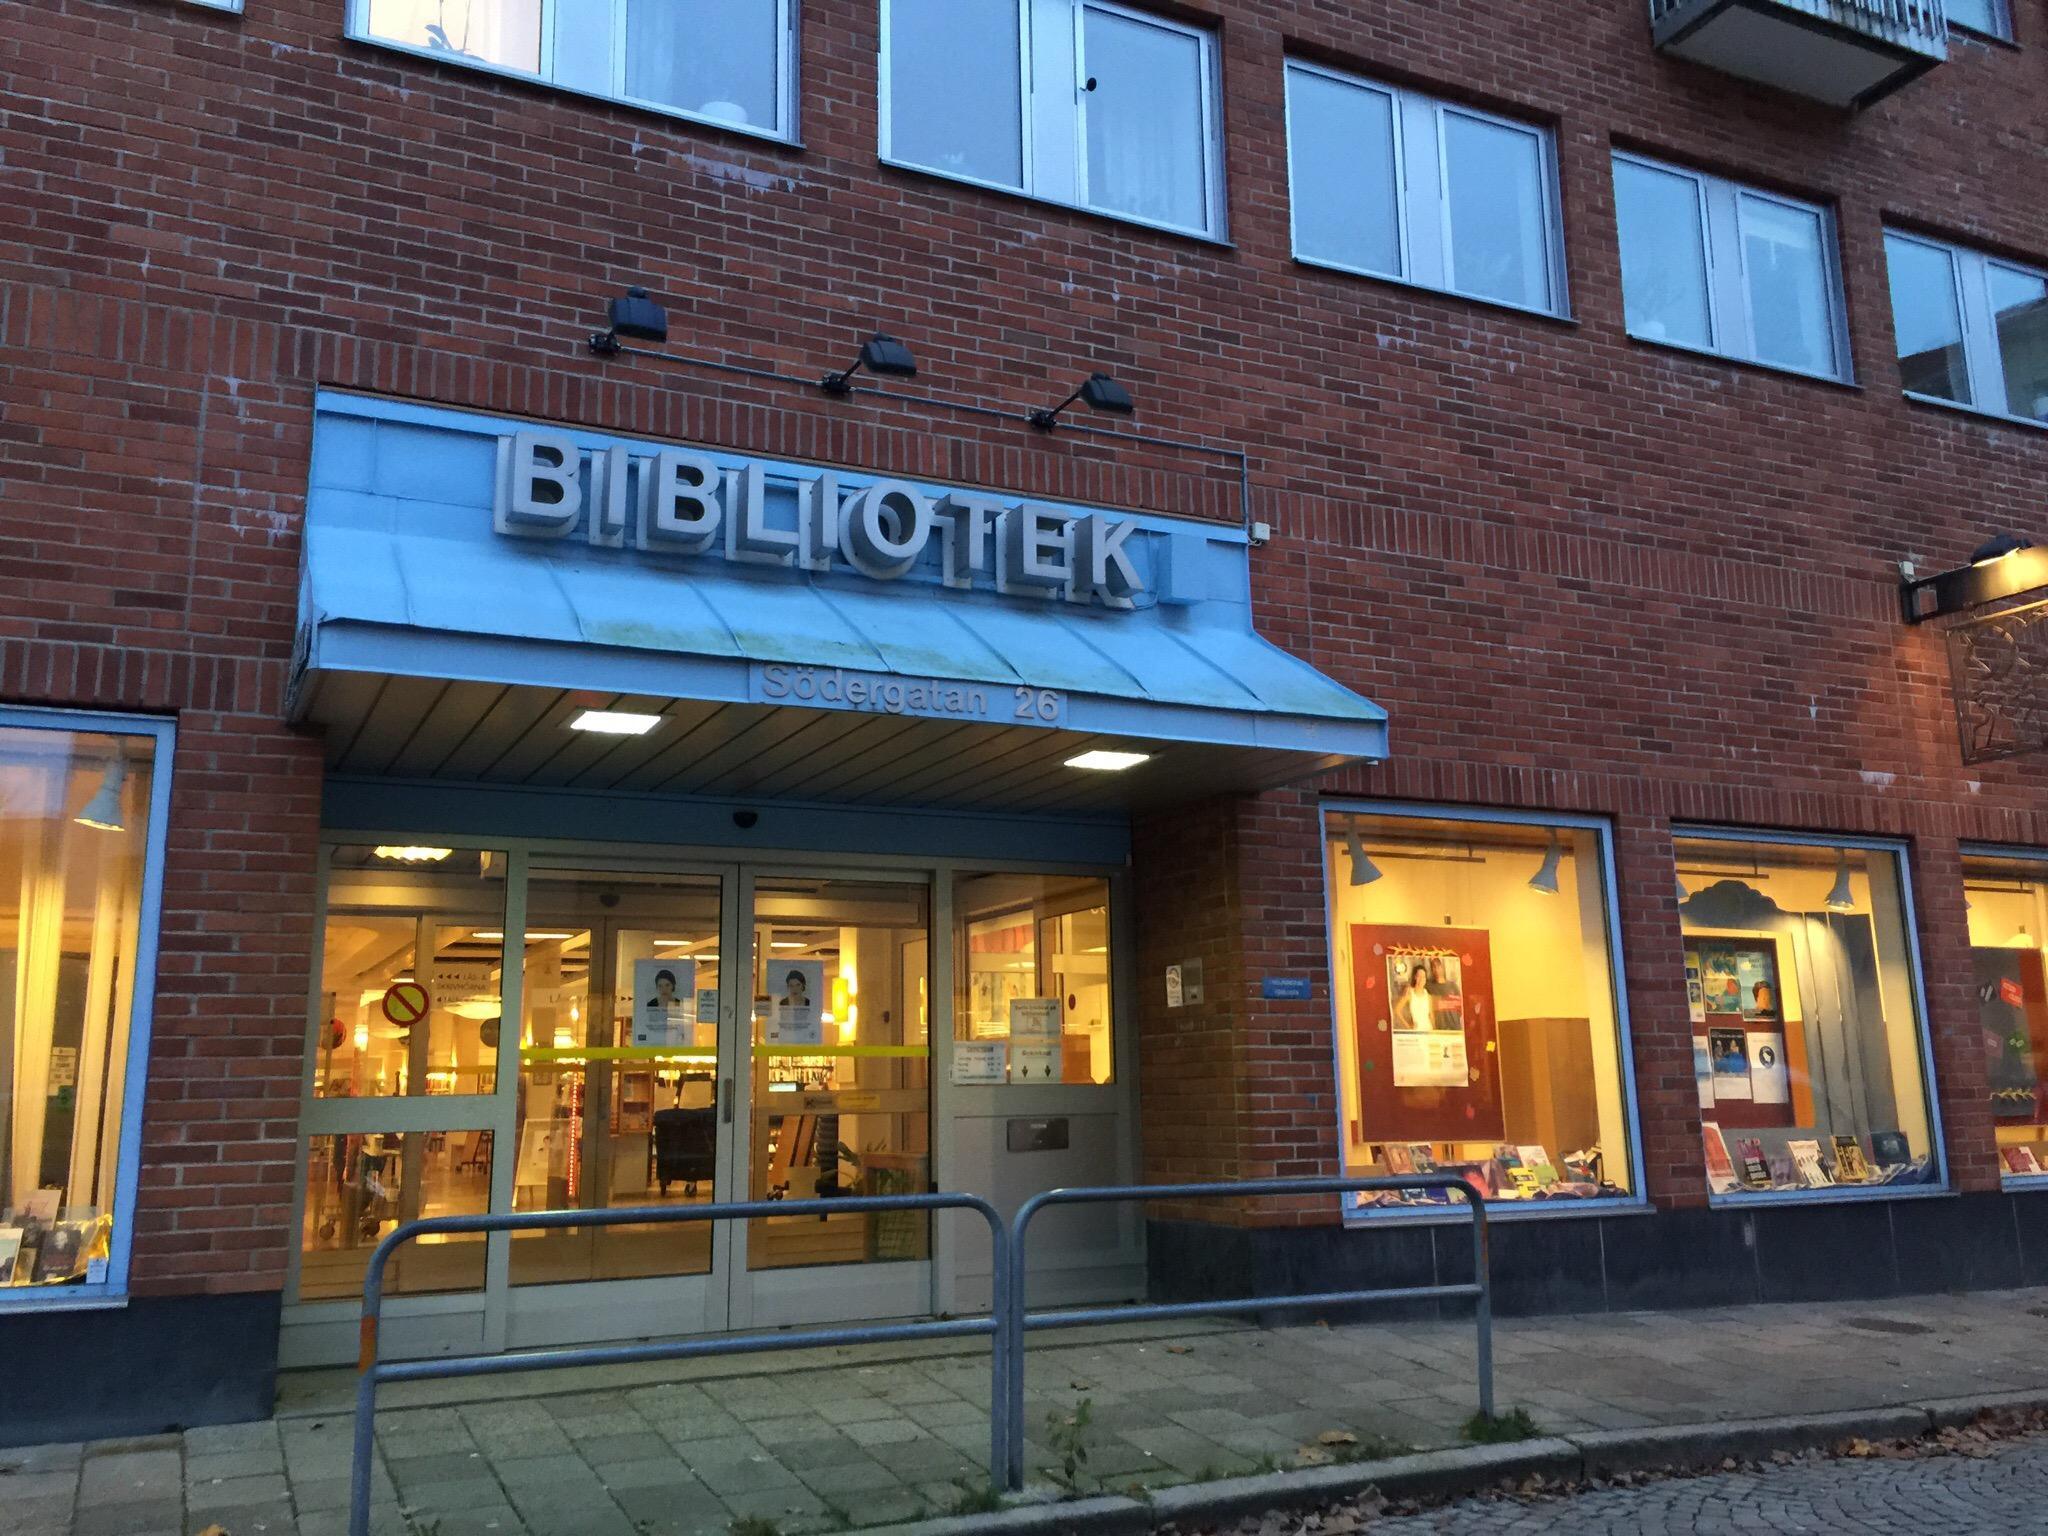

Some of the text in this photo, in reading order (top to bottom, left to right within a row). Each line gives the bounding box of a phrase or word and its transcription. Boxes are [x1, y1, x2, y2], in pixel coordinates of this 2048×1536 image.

[495, 431, 1144, 611] BIBLIOTEK
[762, 664, 1060, 721] Södergatan 26
